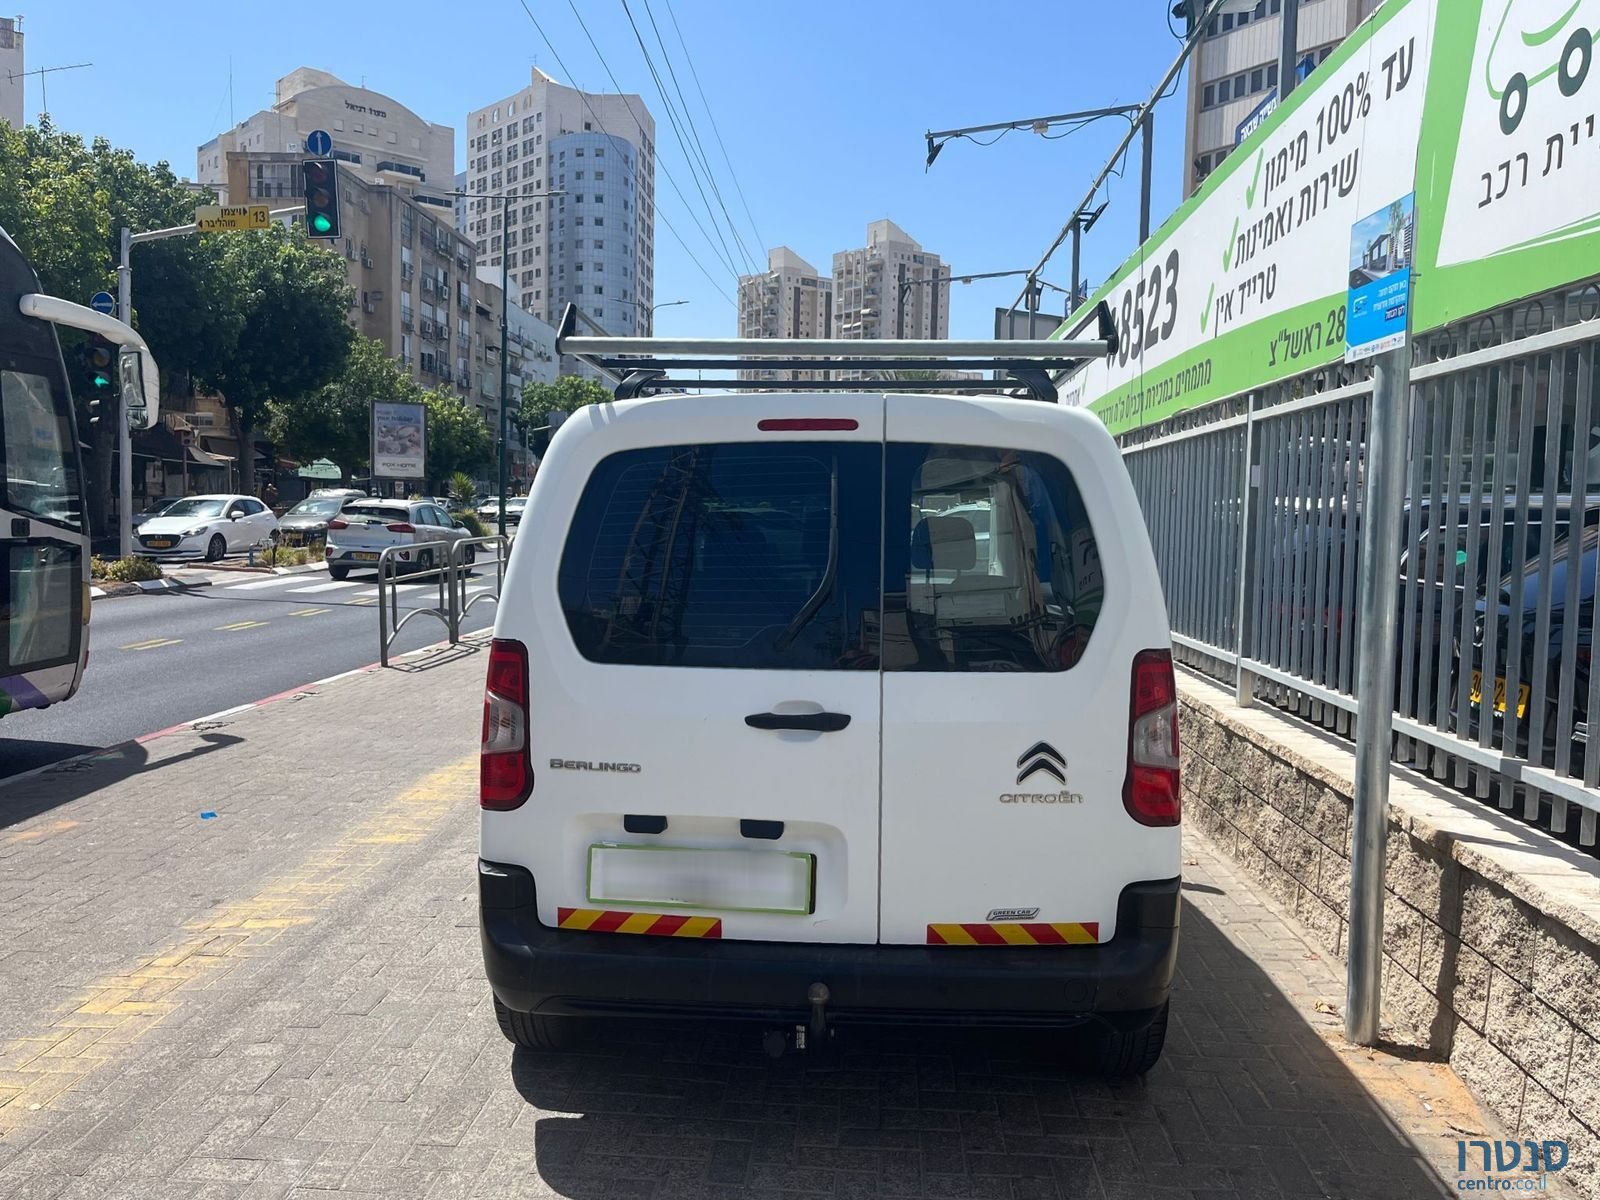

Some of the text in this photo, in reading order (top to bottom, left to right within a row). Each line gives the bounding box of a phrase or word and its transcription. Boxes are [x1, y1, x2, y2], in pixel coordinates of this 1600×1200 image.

[1381, 36, 1416, 102] עד
[1315, 70, 1372, 155] 100%
[1263, 129, 1309, 209] מימון
[1478, 113, 1600, 209] יית רכב
[253, 210, 266, 223] 13
[1234, 147, 1360, 270] שירות ואמינות
[1213, 262, 1278, 339] טרייד אין
[1324, 304, 1347, 348] 28
[1174, 357, 1212, 398] מתמחים
